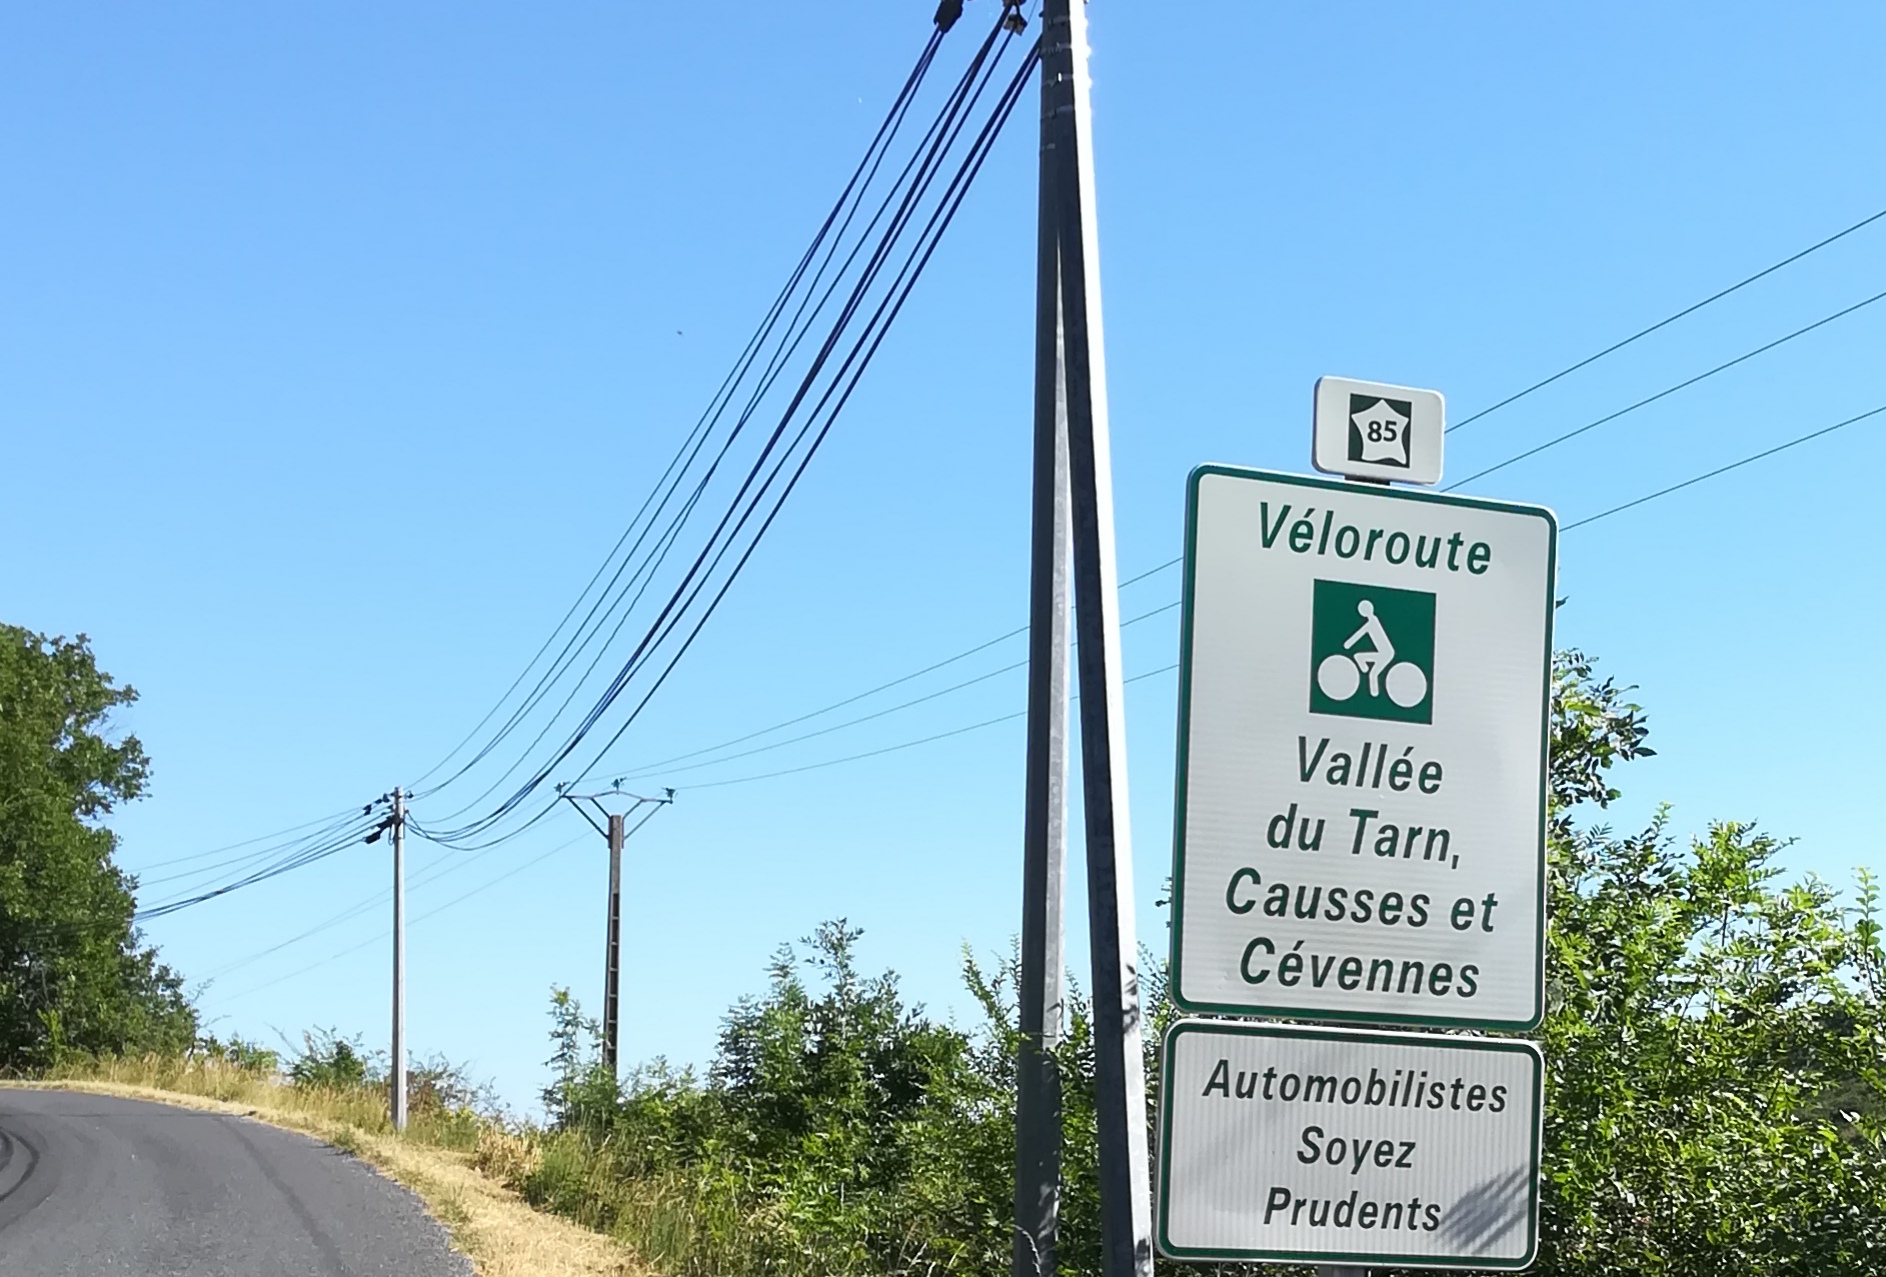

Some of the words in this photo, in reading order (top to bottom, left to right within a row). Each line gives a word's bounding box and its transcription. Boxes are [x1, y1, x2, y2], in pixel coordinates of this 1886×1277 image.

[1367, 420, 1398, 442] 85
[1261, 501, 1492, 575] Véloroute
[1299, 736, 1443, 795] Vallée
[1267, 803, 1326, 852] du
[1350, 808, 1460, 870] Tarn,
[1226, 867, 1430, 928] Causses
[1451, 893, 1499, 933] et
[1241, 937, 1480, 998] Cévennes
[1202, 1059, 1508, 1113] Automobilistes
[1297, 1126, 1417, 1175] Soyez
[1264, 1187, 1442, 1232] Prudents
